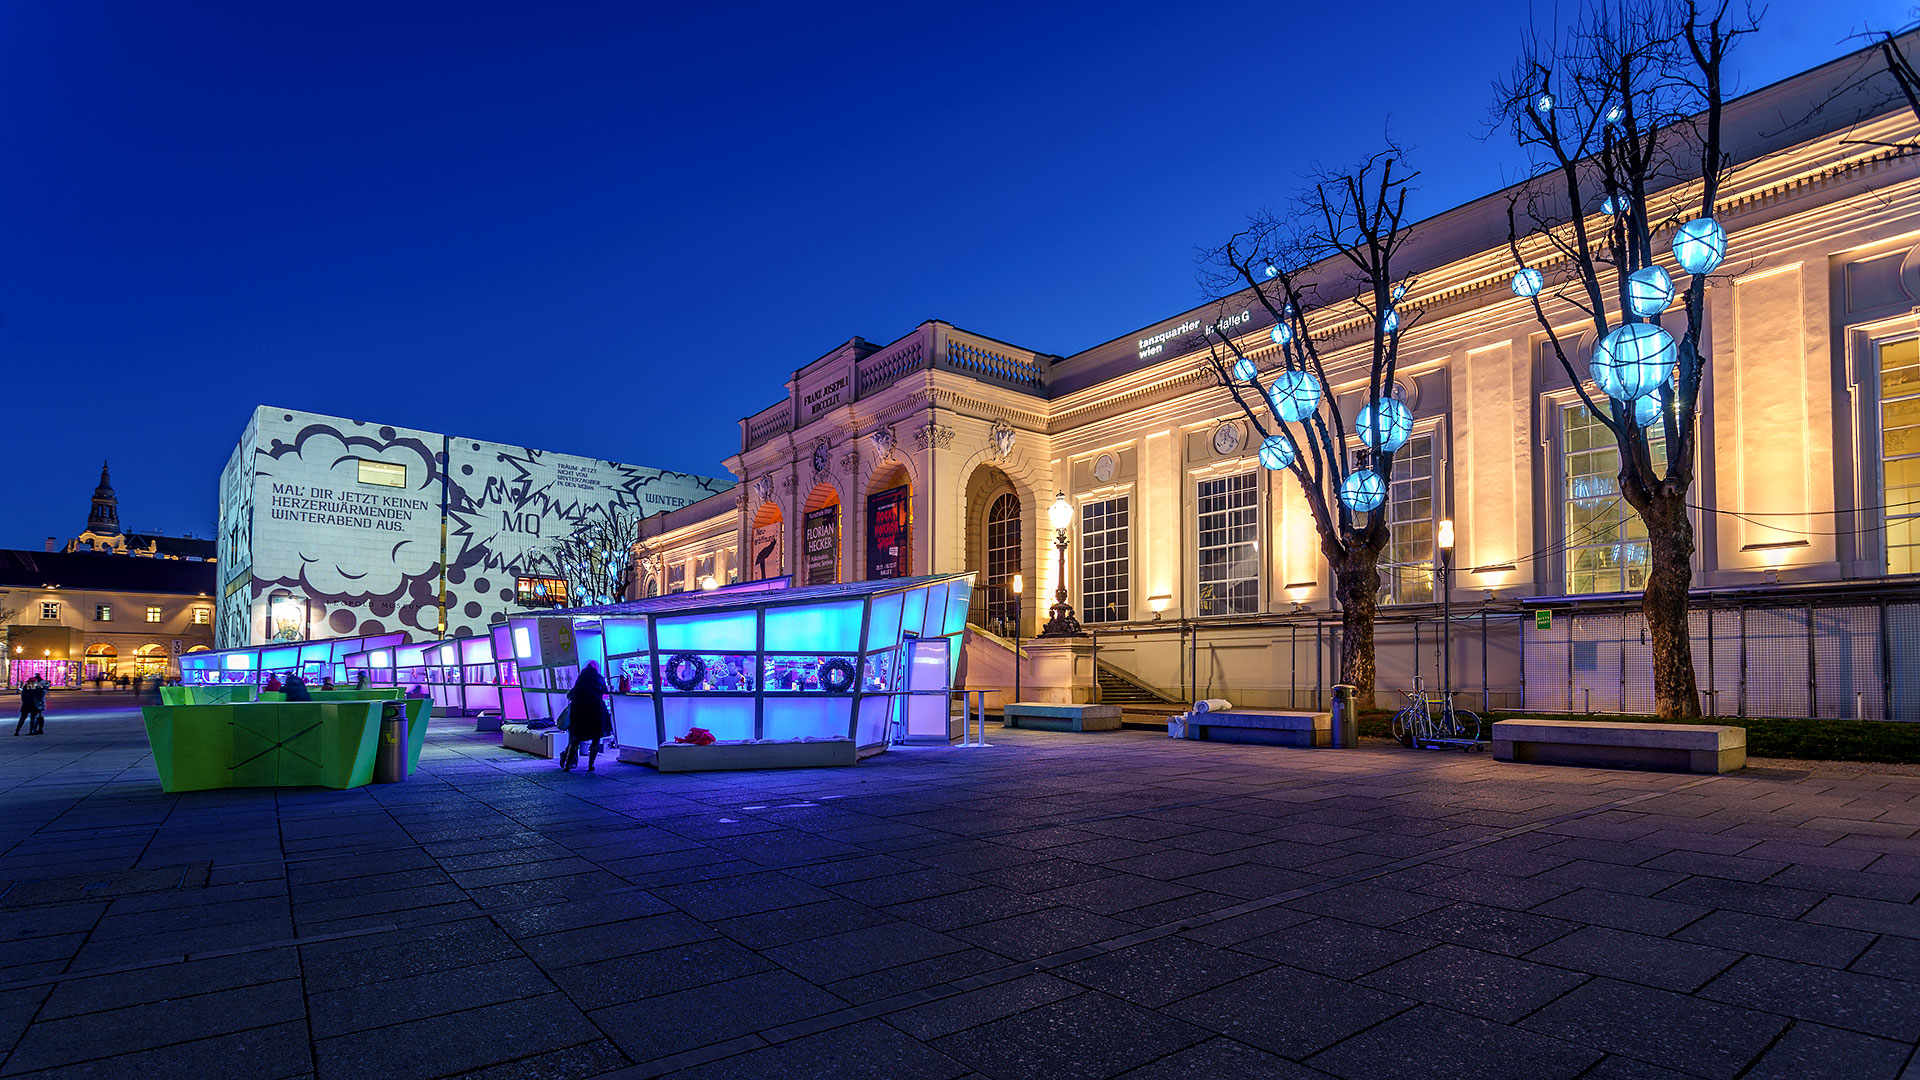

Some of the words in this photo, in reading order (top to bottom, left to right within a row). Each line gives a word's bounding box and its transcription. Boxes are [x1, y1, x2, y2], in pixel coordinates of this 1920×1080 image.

[1139, 320, 1200, 348] tanzquartier
[1241, 311, 1250, 322] G
[1139, 344, 1163, 359] wien
[272, 496, 412, 520] HERZERWÄRMENDEN
[310, 487, 333, 500] DIR
[337, 491, 379, 505] JETZT
[382, 495, 429, 511] KEINEN
[645, 493, 685, 507] WINTER
[272, 508, 372, 528] WINTERABEND
[375, 519, 405, 532] AUS.
[501, 510, 541, 539] MQ
[807, 523, 834, 540] FLORIAN
[808, 537, 832, 552] HECKER
[326, 599, 374, 608] LEOPOLD
[381, 602, 422, 610] MUSEUM
